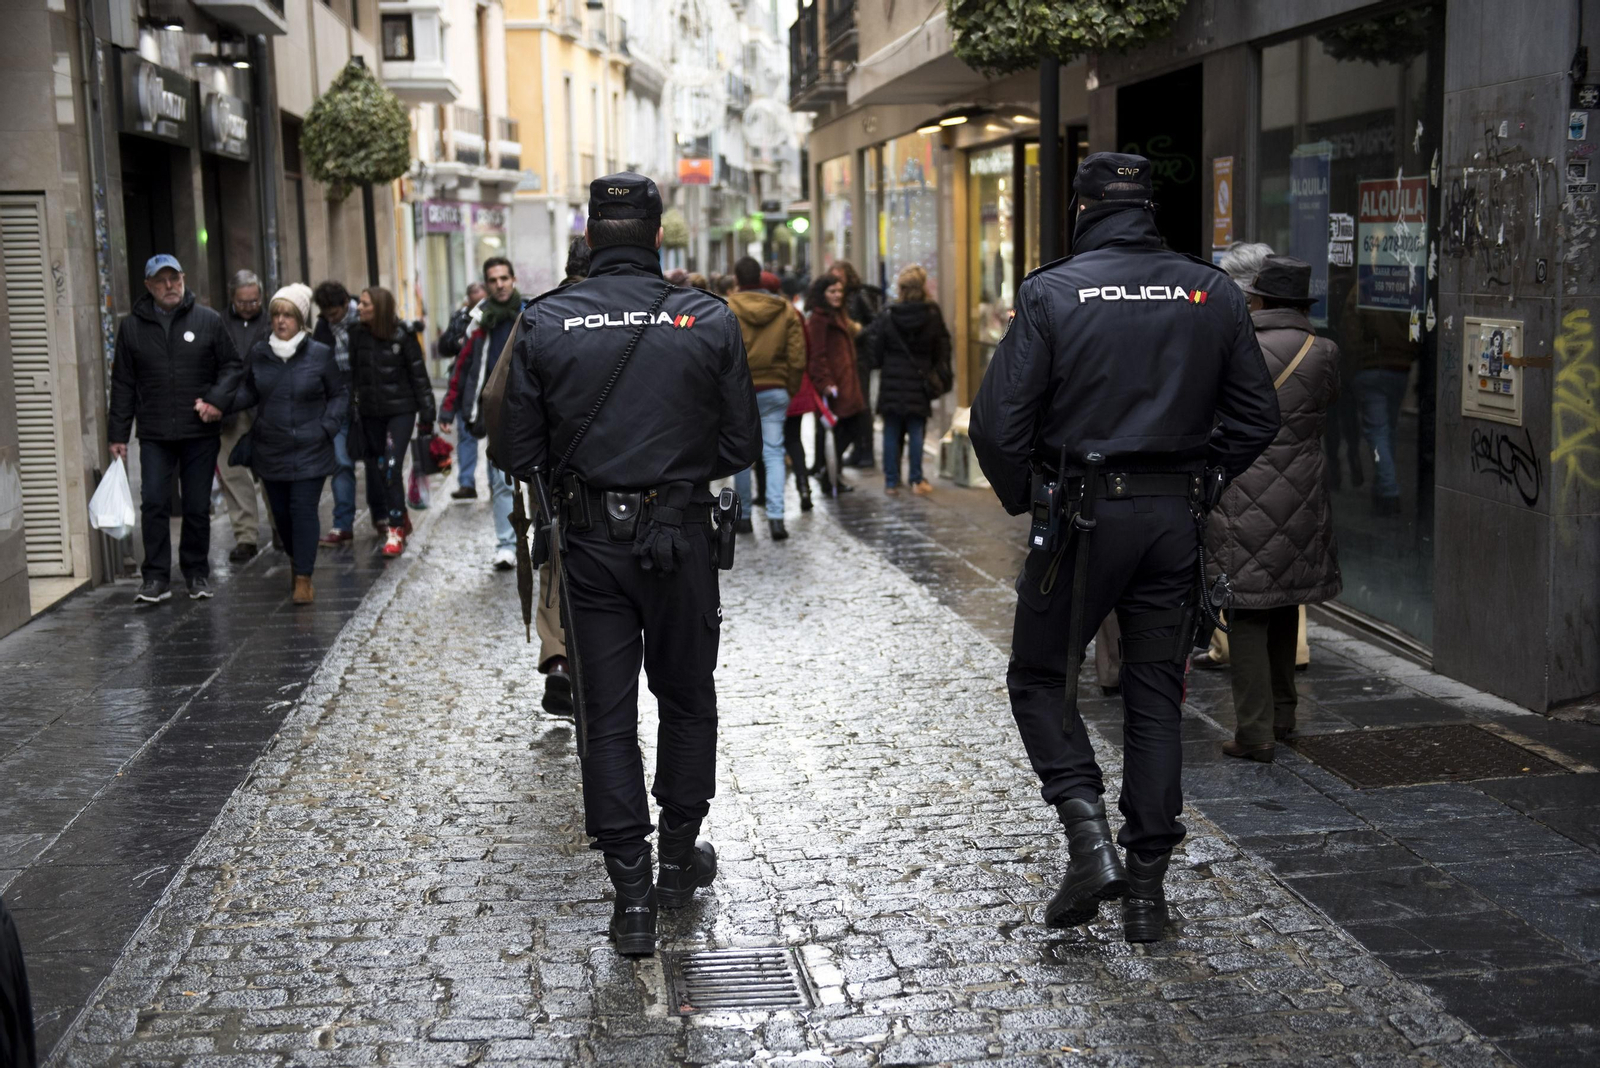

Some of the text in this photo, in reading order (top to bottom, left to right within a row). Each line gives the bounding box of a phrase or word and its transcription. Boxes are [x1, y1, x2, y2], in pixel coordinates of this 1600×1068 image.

[1117, 167, 1140, 177] CNP
[607, 187, 631, 197] CNP
[1291, 178, 1328, 196] ALQUILA
[1360, 188, 1424, 217] ALQUILA
[1382, 235, 1399, 252] 278
[1078, 285, 1190, 304] POLICIA
[563, 311, 675, 331] POLICIA
